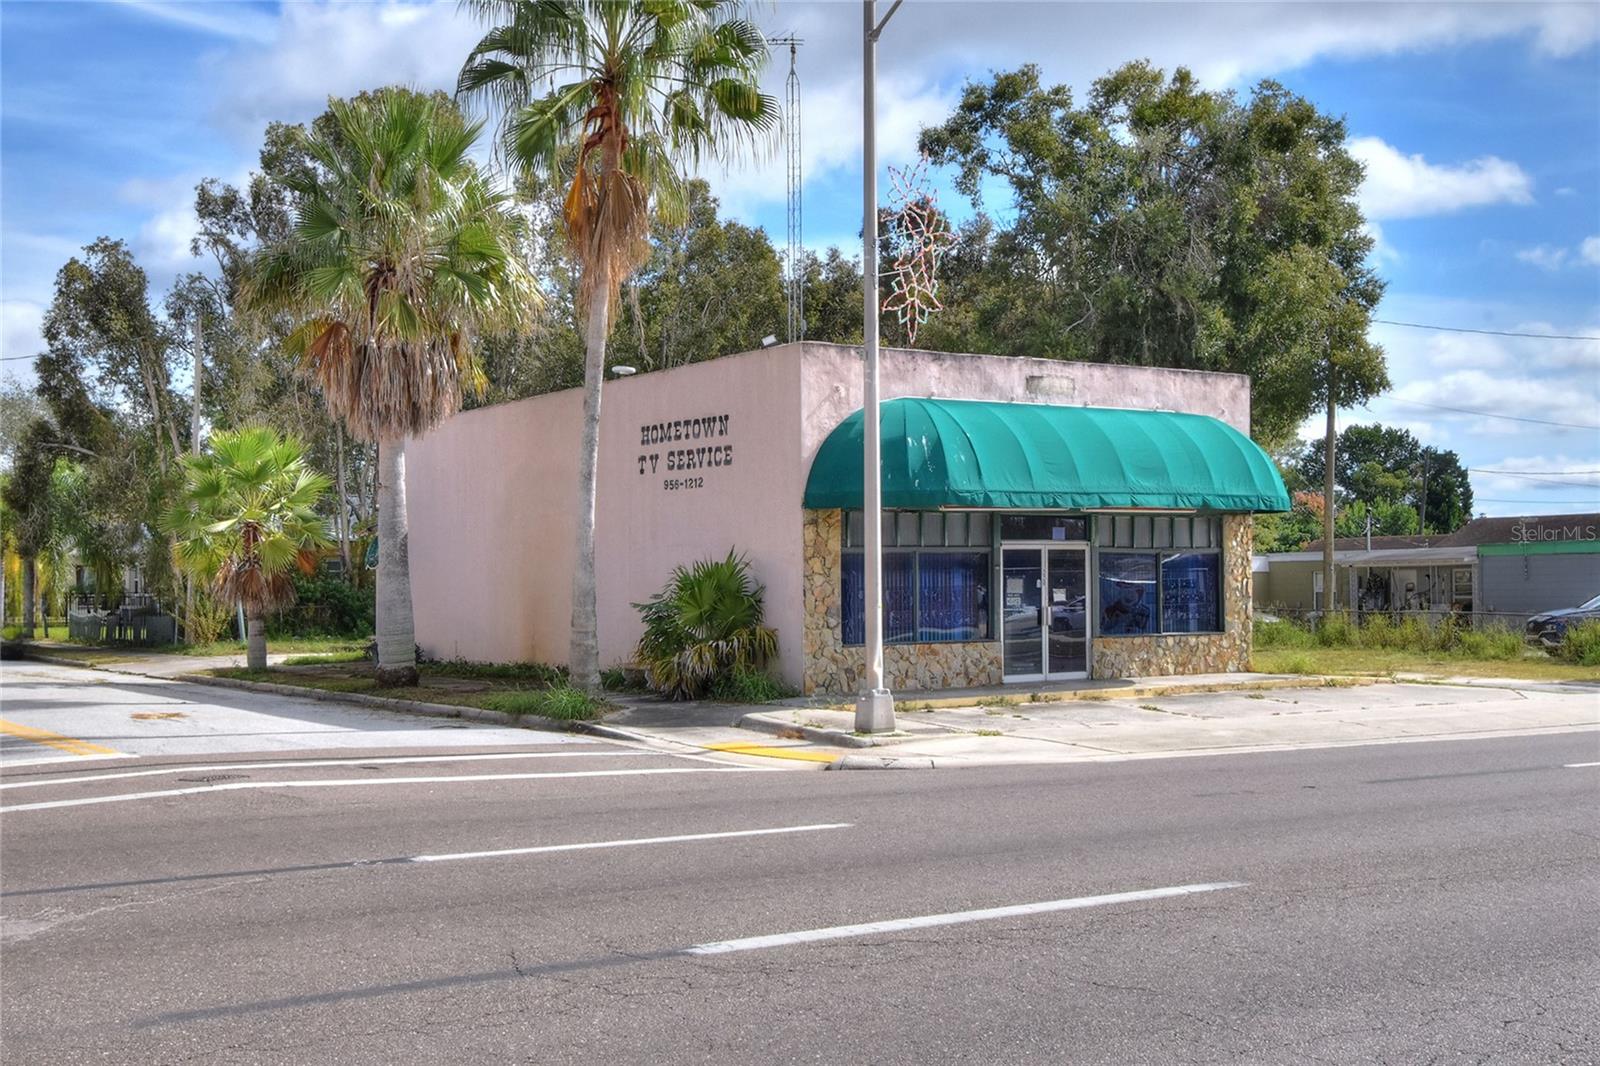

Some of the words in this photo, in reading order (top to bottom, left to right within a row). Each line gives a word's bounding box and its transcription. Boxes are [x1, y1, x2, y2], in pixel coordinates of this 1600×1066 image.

[641, 414, 729, 445] HOMETOWN
[638, 453, 660, 475] TV
[667, 445, 732, 470] SERVICE
